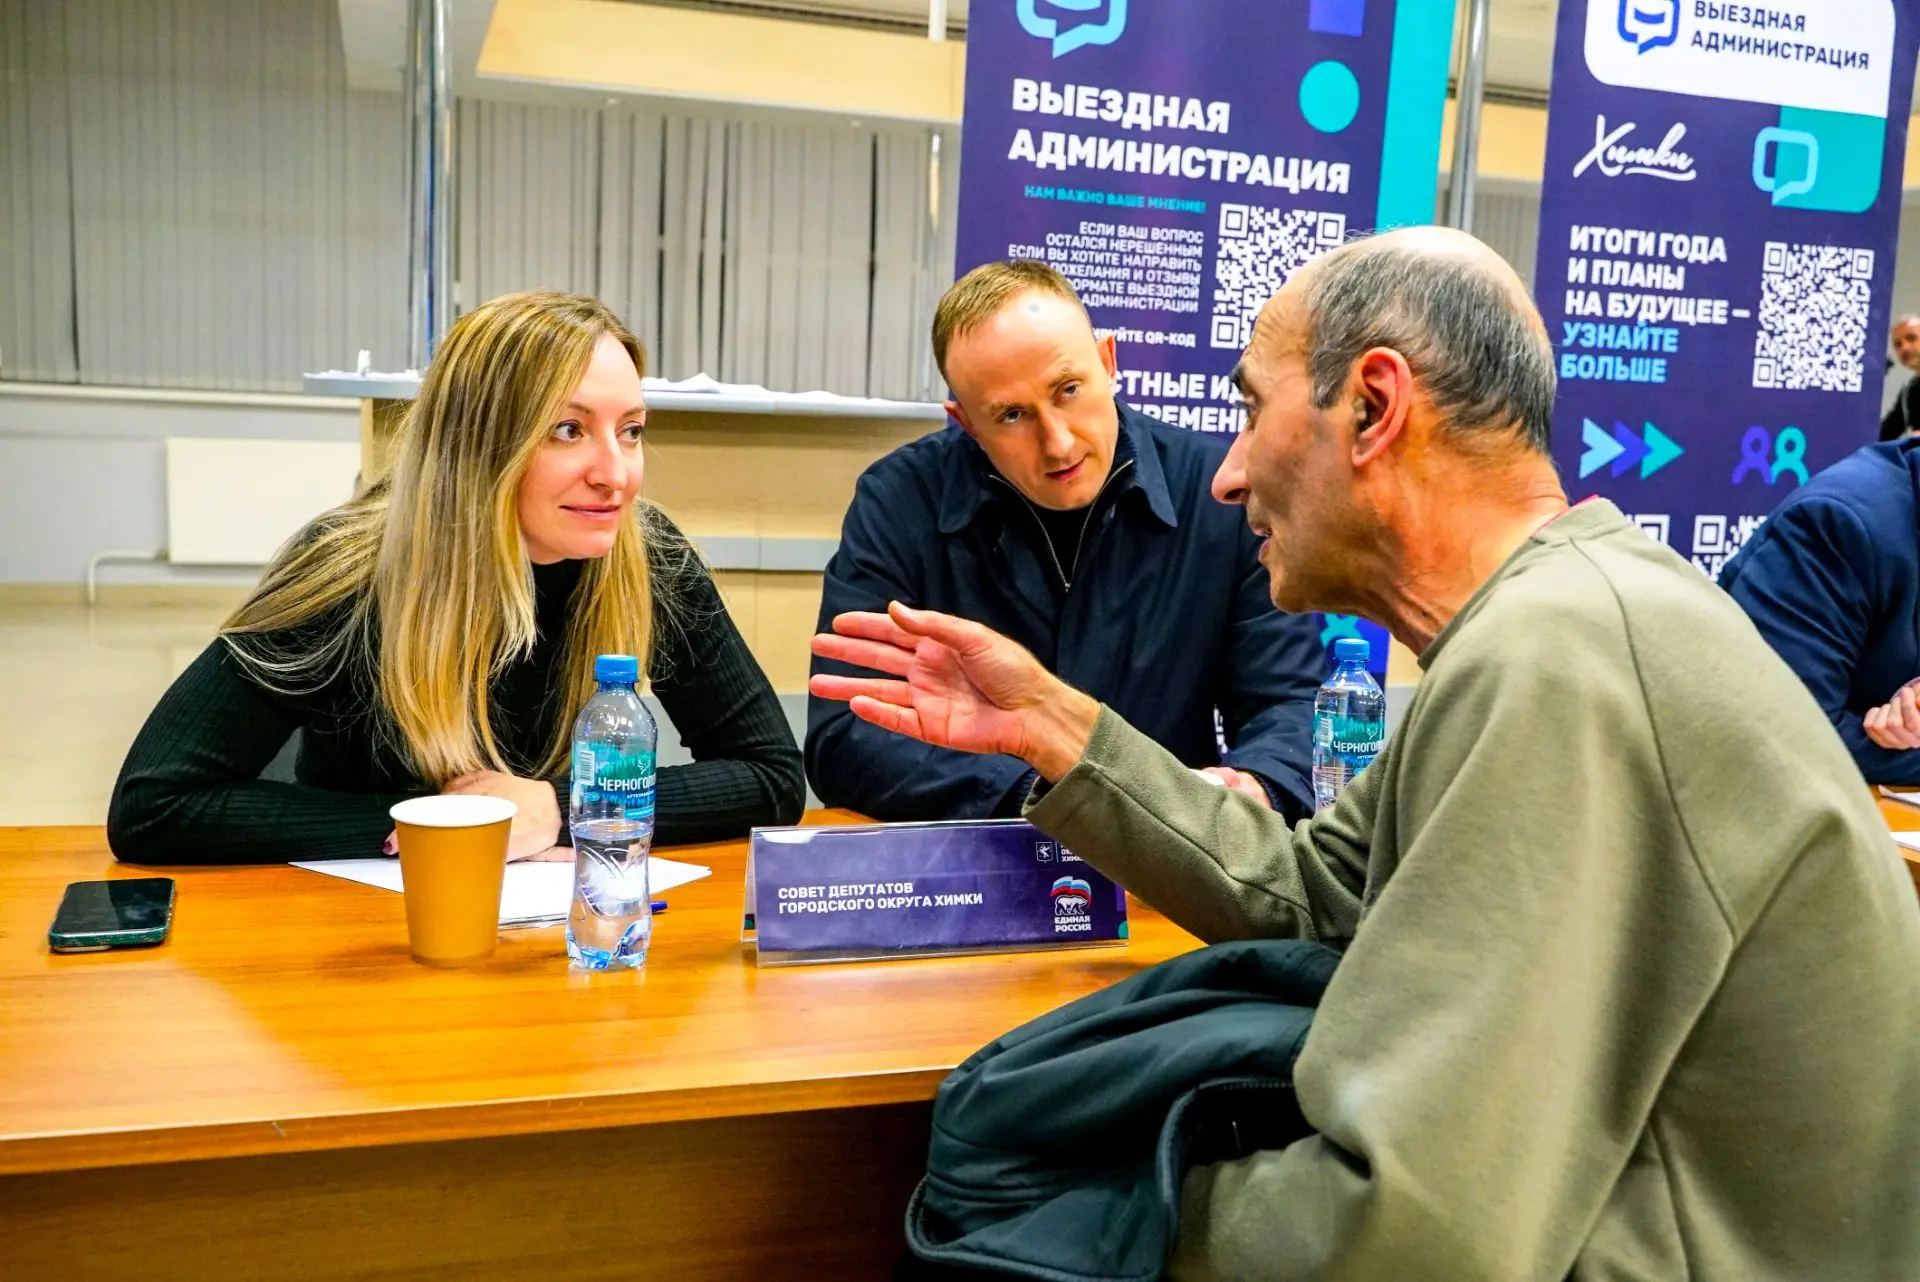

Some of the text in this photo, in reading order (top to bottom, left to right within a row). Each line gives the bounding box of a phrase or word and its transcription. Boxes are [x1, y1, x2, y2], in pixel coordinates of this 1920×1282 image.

[1694, 1, 1806, 32] ВЫЕЗДНАЯ
[1690, 30, 1870, 70] АДМИНИСТРАЦИЯ
[1012, 78, 1231, 134] ВЫЕЗДНАЯ
[1573, 114, 1696, 180] Химки
[1007, 129, 1351, 194] АДМИНИСТРАЦИЯ
[1024, 185, 1207, 213] НАМ ВАЖНО ВАШЕ МНЕНИЕ!
[1045, 232, 1107, 250] ОСТАЛСЯ
[1080, 221, 1204, 244] ЕСЛИ ВАШ ВОПРОС
[1570, 224, 1728, 264] ИТОГИ ГОДА
[1008, 243, 1202, 272] ЕСЛИ ВЫ ХОТИТЕ НАПРАВИТЬ
[1133, 268, 1144, 281] И
[1146, 269, 1201, 285] ОТЗЫВЫ
[1567, 257, 1686, 291] И ПЛАНЫ
[1067, 278, 1200, 299] ОРМАТЕ ВЫЕЗДНОЙ
[1081, 293, 1199, 313] АДМИНИСТРАЦИИ
[1565, 289, 1603, 316] НА
[1607, 292, 1729, 326] БУДУЩЕЕ
[1145, 331, 1196, 349] QR-КОД
[1562, 320, 1680, 353] УЗНАЙТЕ
[1560, 353, 1668, 383] БОЛЬШЕ
[778, 882, 914, 900] СОВЕТ ДЕПУТАТОВ
[779, 893, 983, 914] ГОРОДСКОГО ОКРУГА ХИМКИ
[1054, 915, 1091, 925] ЕДИНАЯ
[1055, 923, 1092, 933] РОССИЯ
